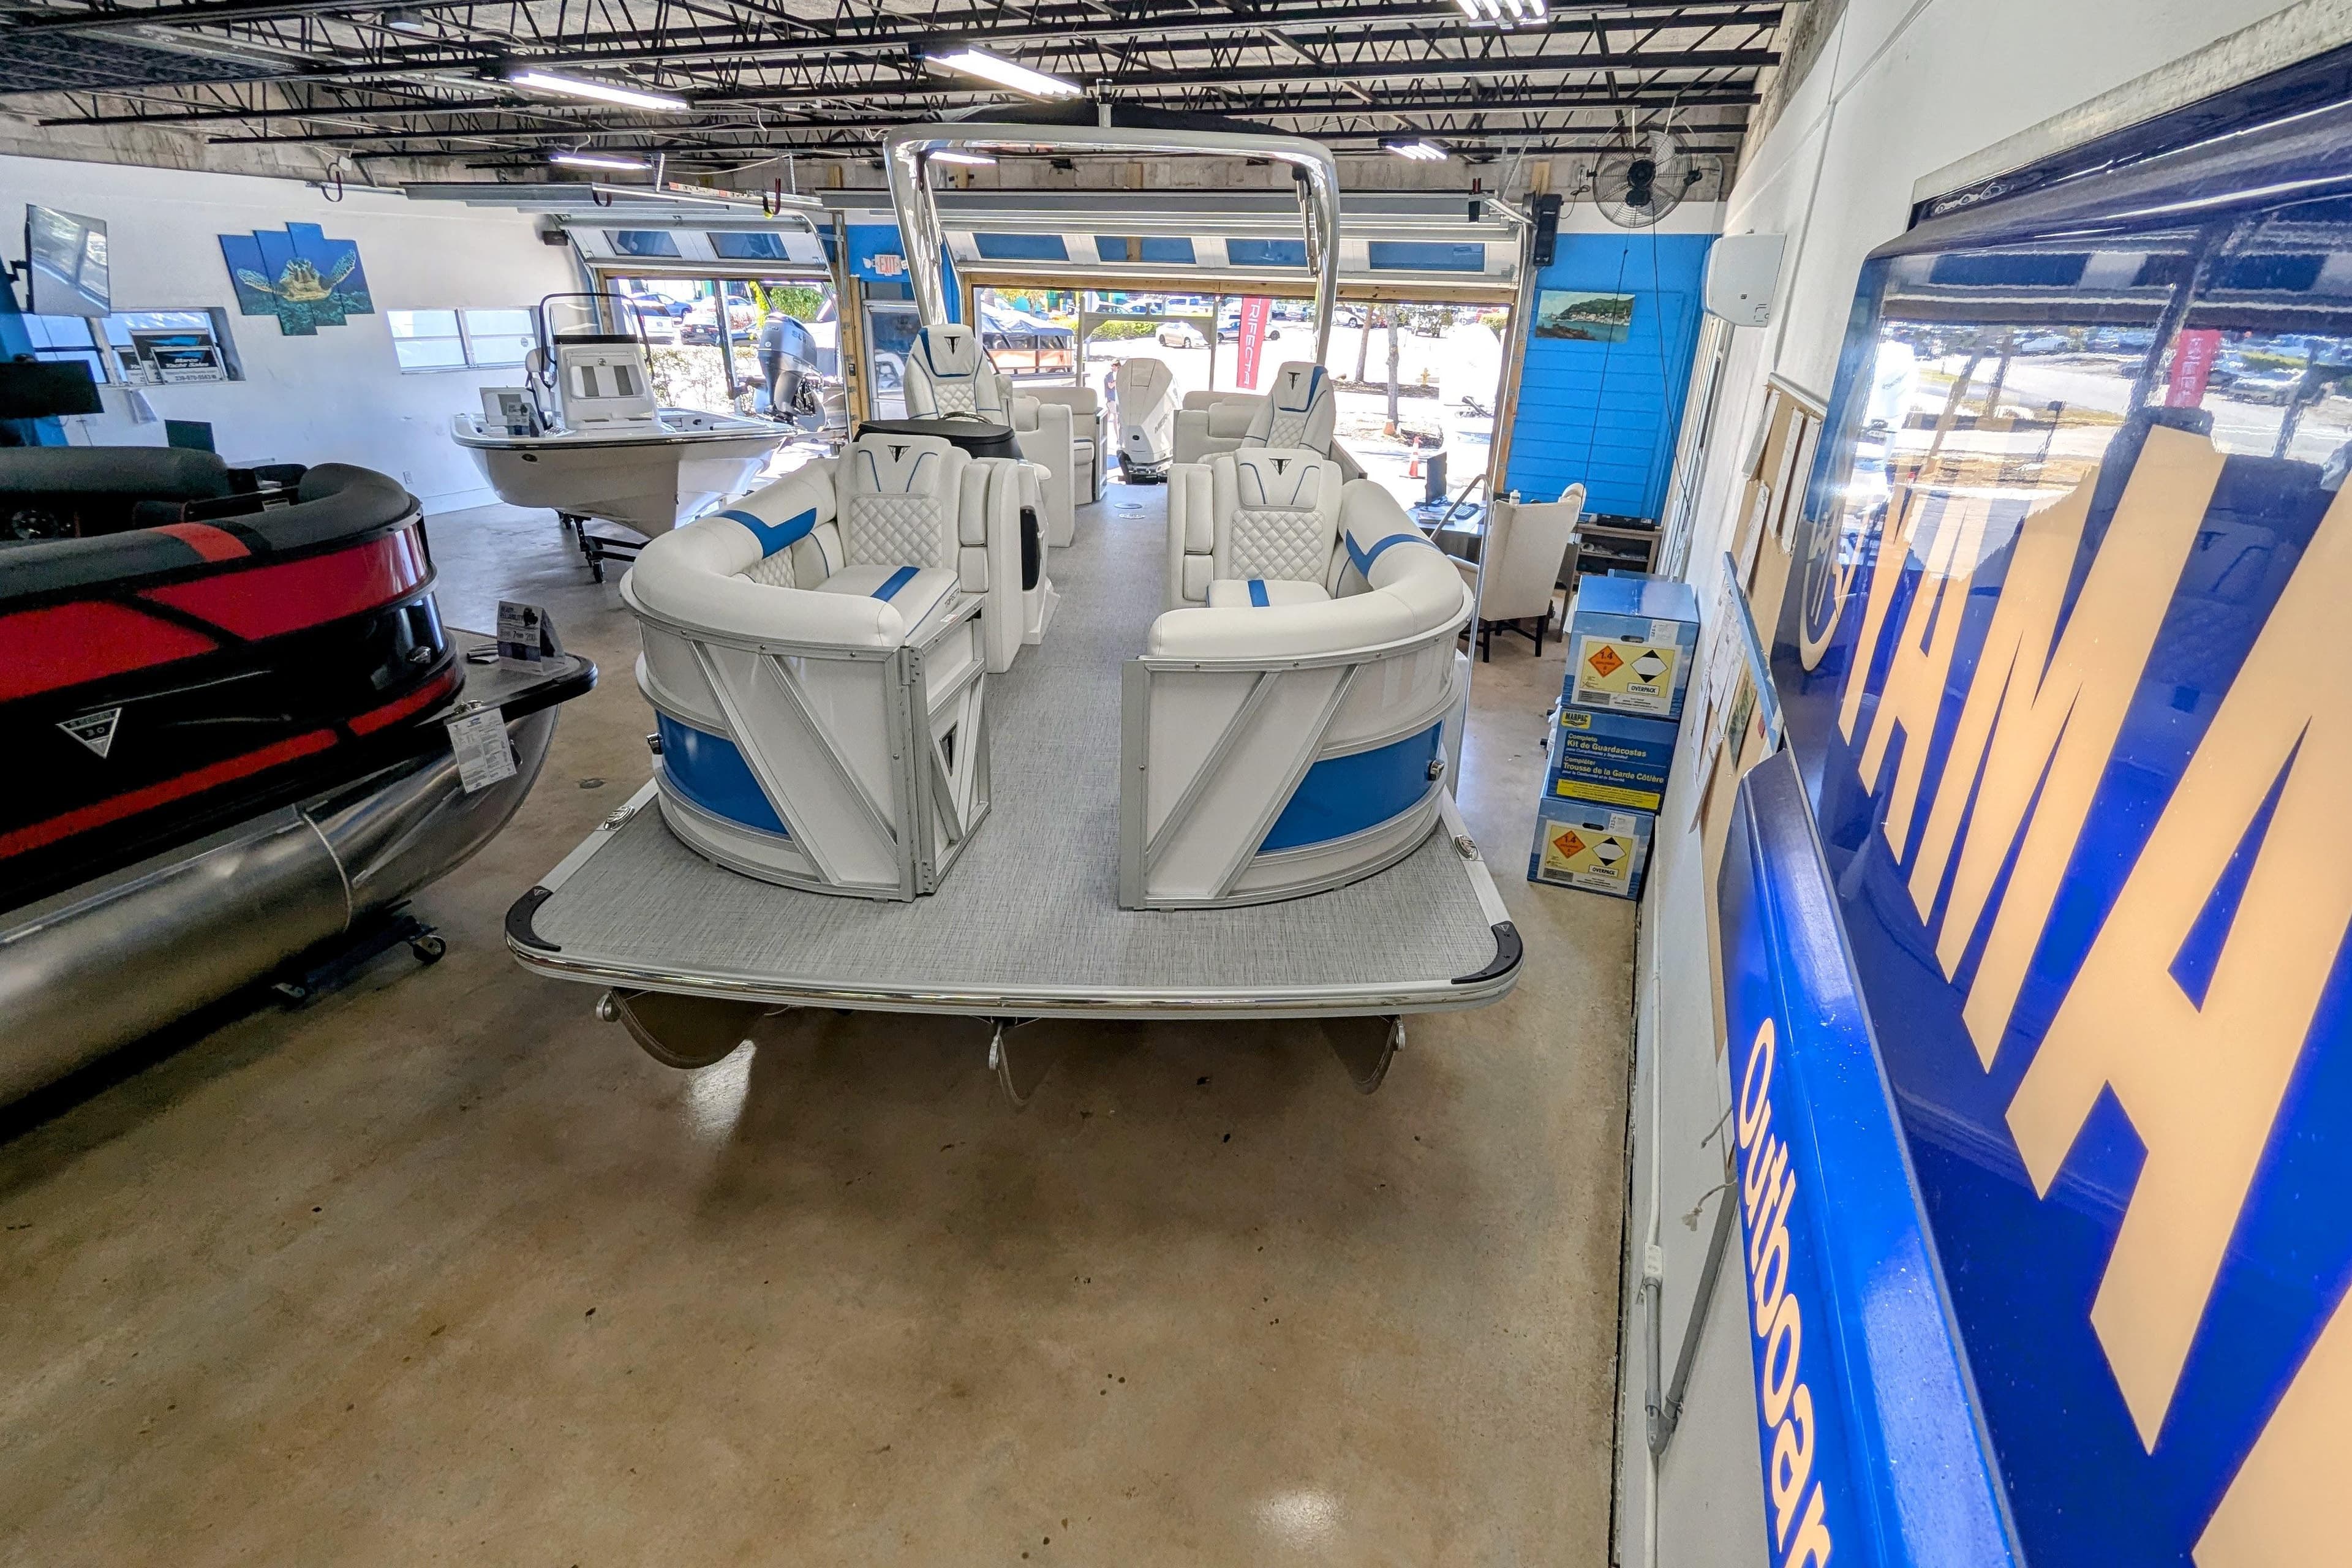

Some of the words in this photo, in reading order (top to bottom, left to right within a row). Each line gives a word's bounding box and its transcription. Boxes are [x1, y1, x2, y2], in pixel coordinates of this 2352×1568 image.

[880, 256, 896, 273] EXIT
[1600, 651, 1613, 660] 1.4
[1565, 712, 1588, 723] MARPAC
[1568, 733, 1597, 743] Completo
[1592, 744, 1647, 758] Guardacostas
[1563, 763, 1591, 772] Trousse
[1612, 769, 1635, 779] Garde
[1592, 867, 1616, 875] OVERPACK
[1838, 423, 2352, 1568] YAMA
